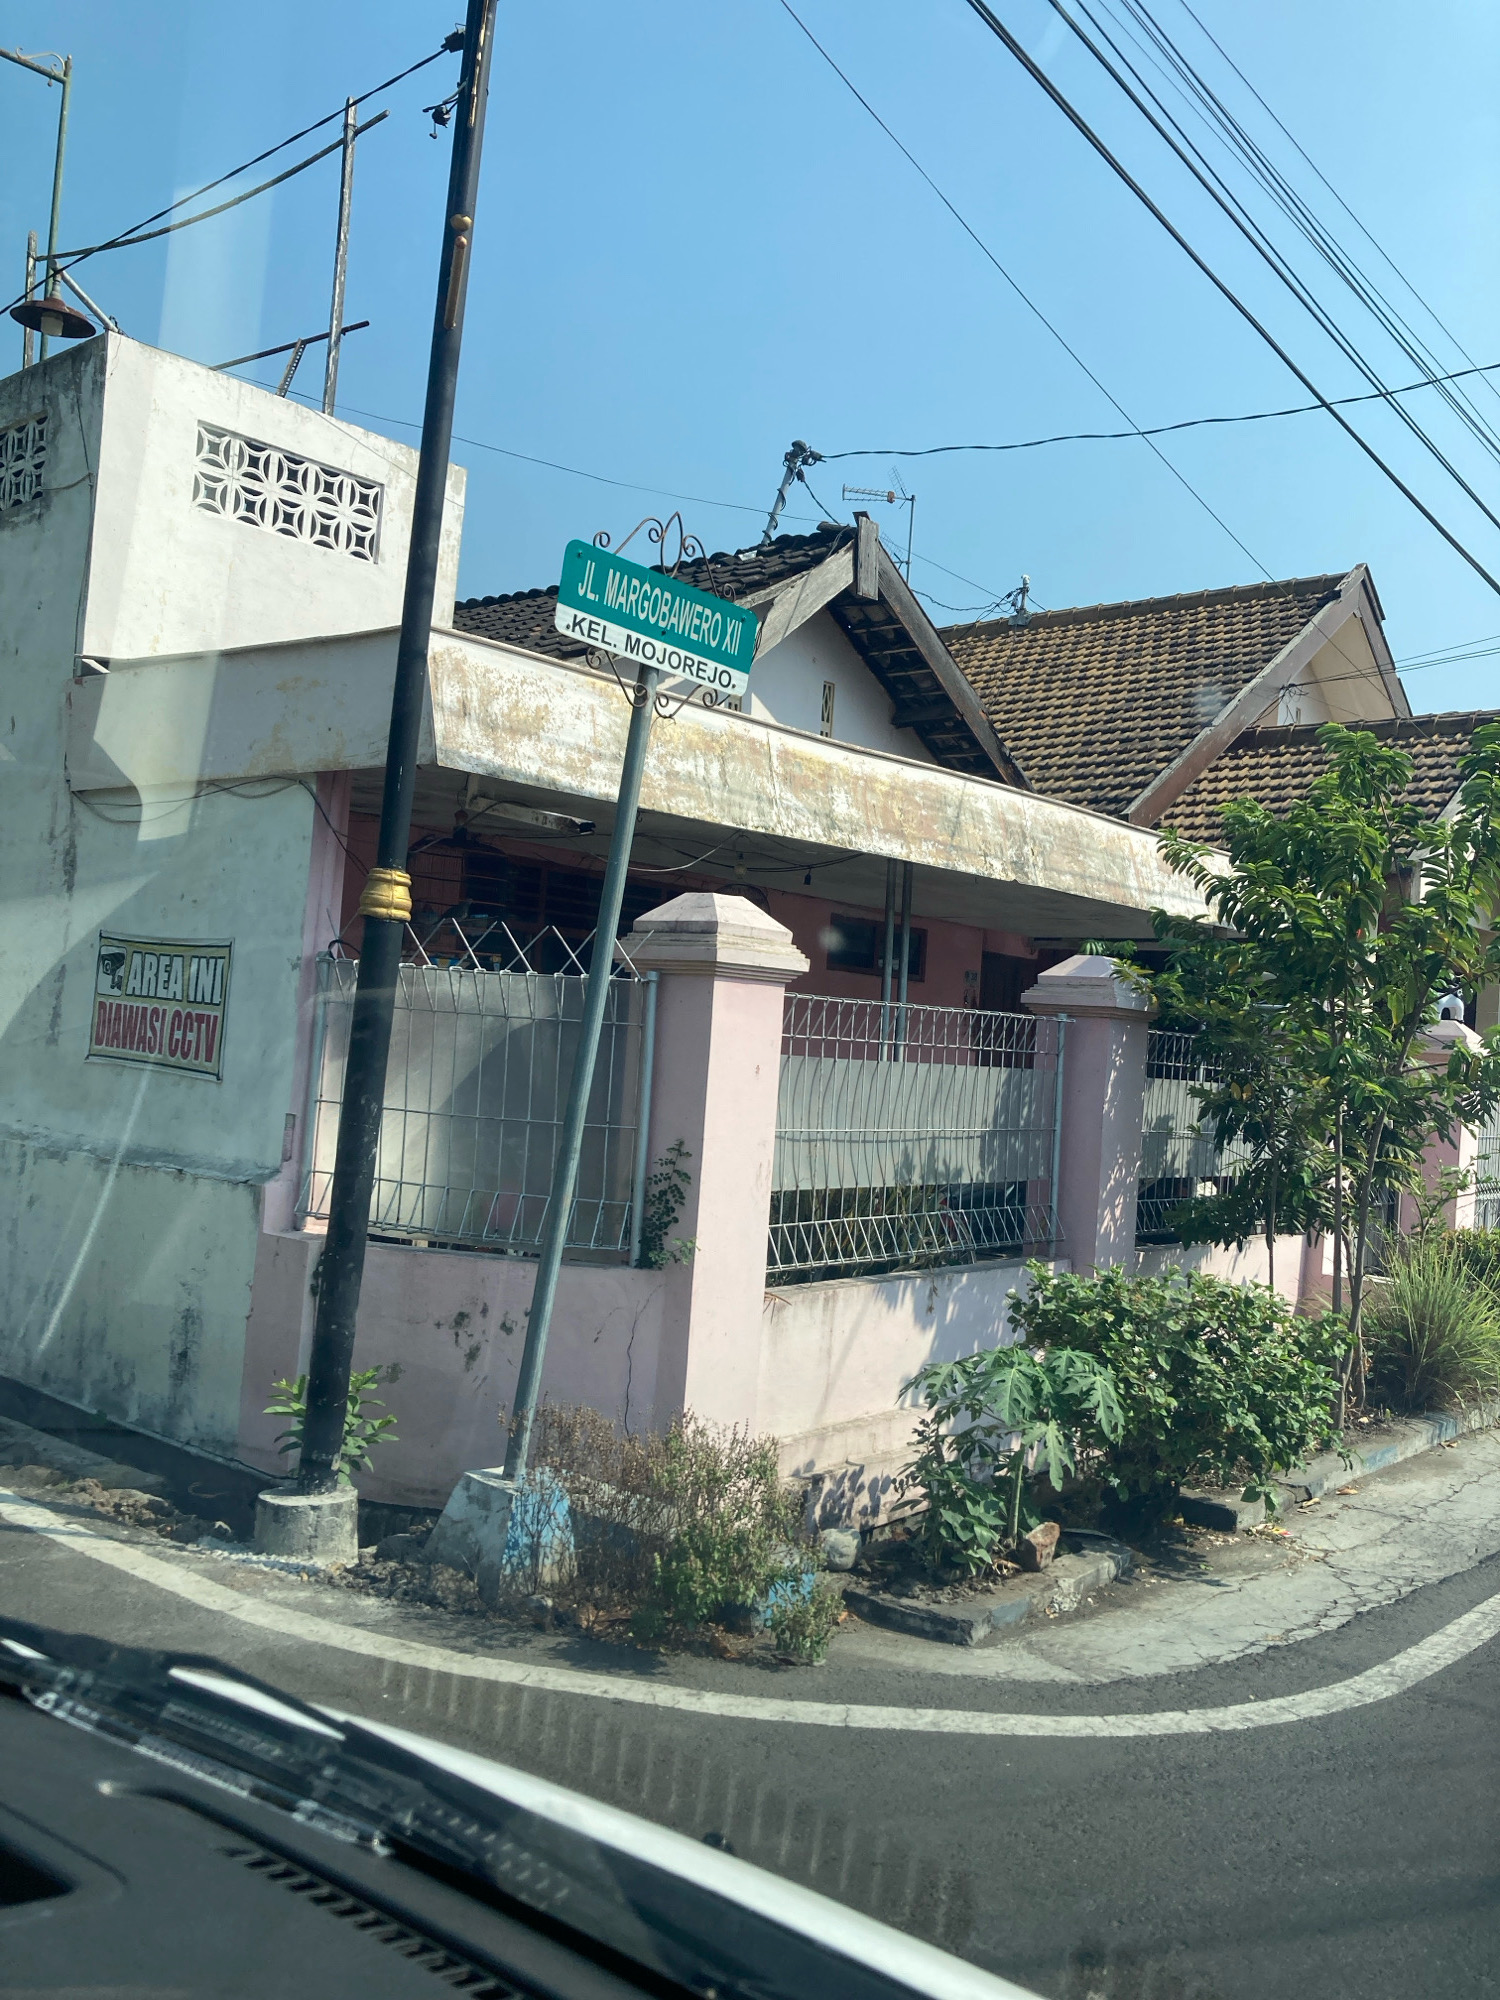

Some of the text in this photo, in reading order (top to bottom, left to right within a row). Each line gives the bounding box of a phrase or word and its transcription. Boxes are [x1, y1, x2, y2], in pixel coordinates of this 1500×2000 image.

[577, 560, 743, 656] JL. MARGOBAWERO XII
[125, 951, 226, 1006] AREA INI
[94, 1000, 219, 1063] DIAWASI CCTV
